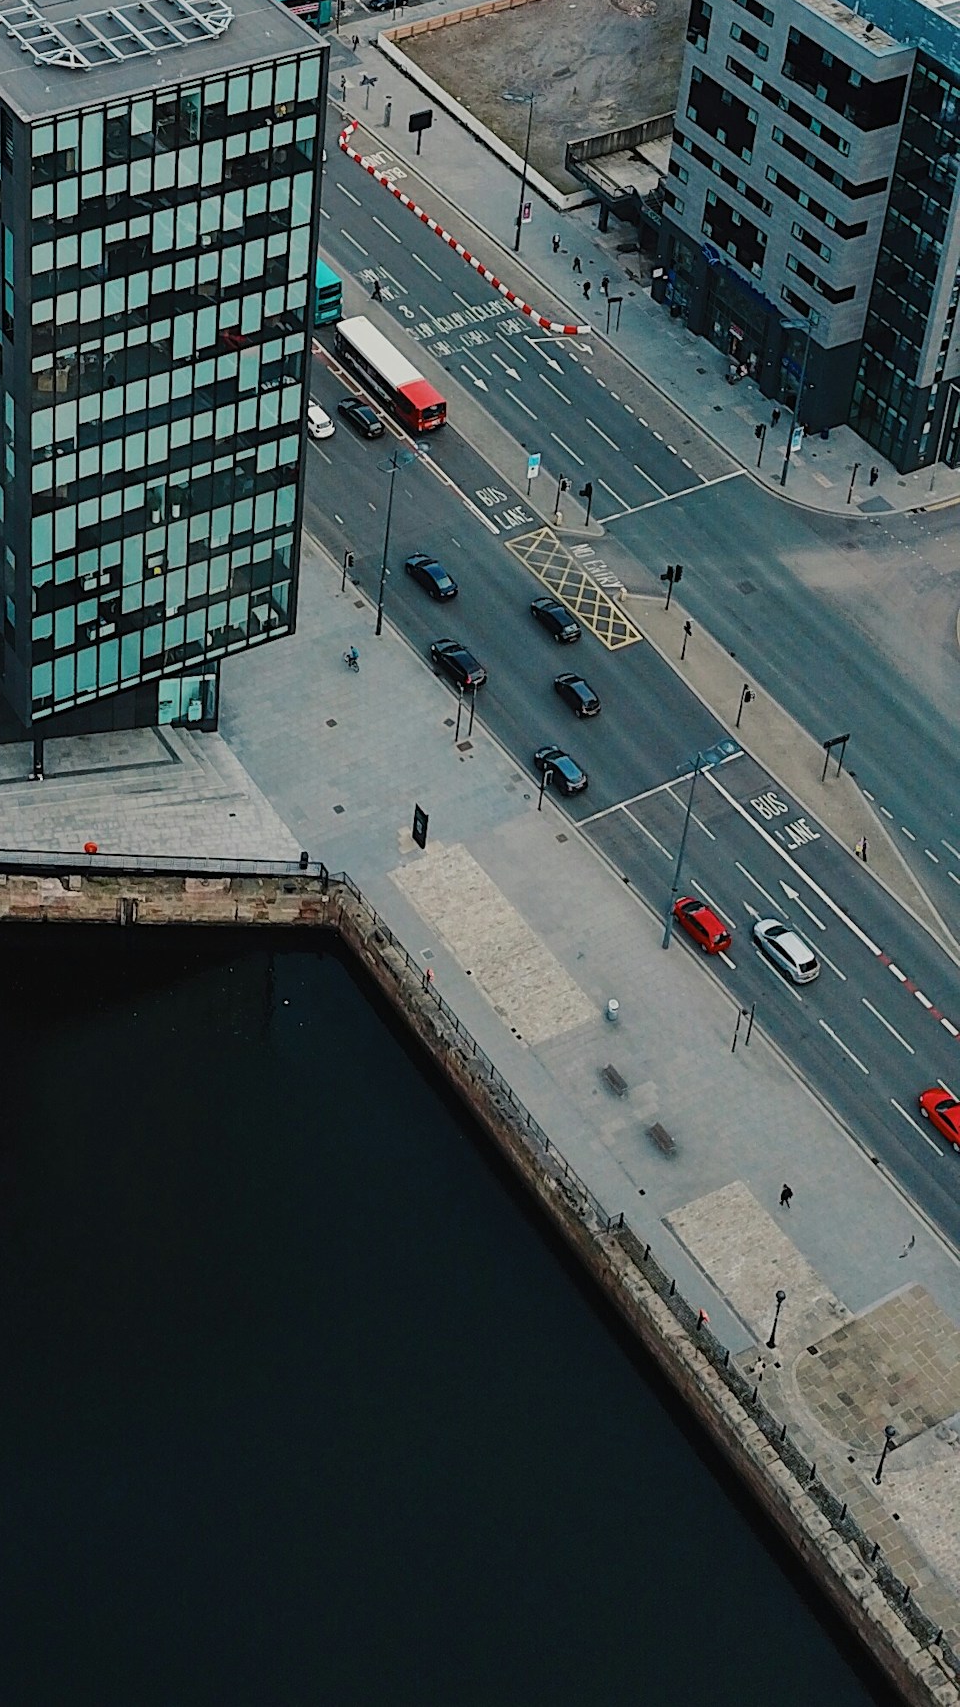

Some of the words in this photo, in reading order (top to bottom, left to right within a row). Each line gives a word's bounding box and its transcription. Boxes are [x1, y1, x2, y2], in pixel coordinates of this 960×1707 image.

[475, 486, 507, 507] BUS
[494, 505, 534, 530] LANE
[569, 543, 595, 558] NO
[583, 559, 625, 588] ENTRY
[750, 792, 789, 820] BUS
[774, 818, 821, 850] LANE
